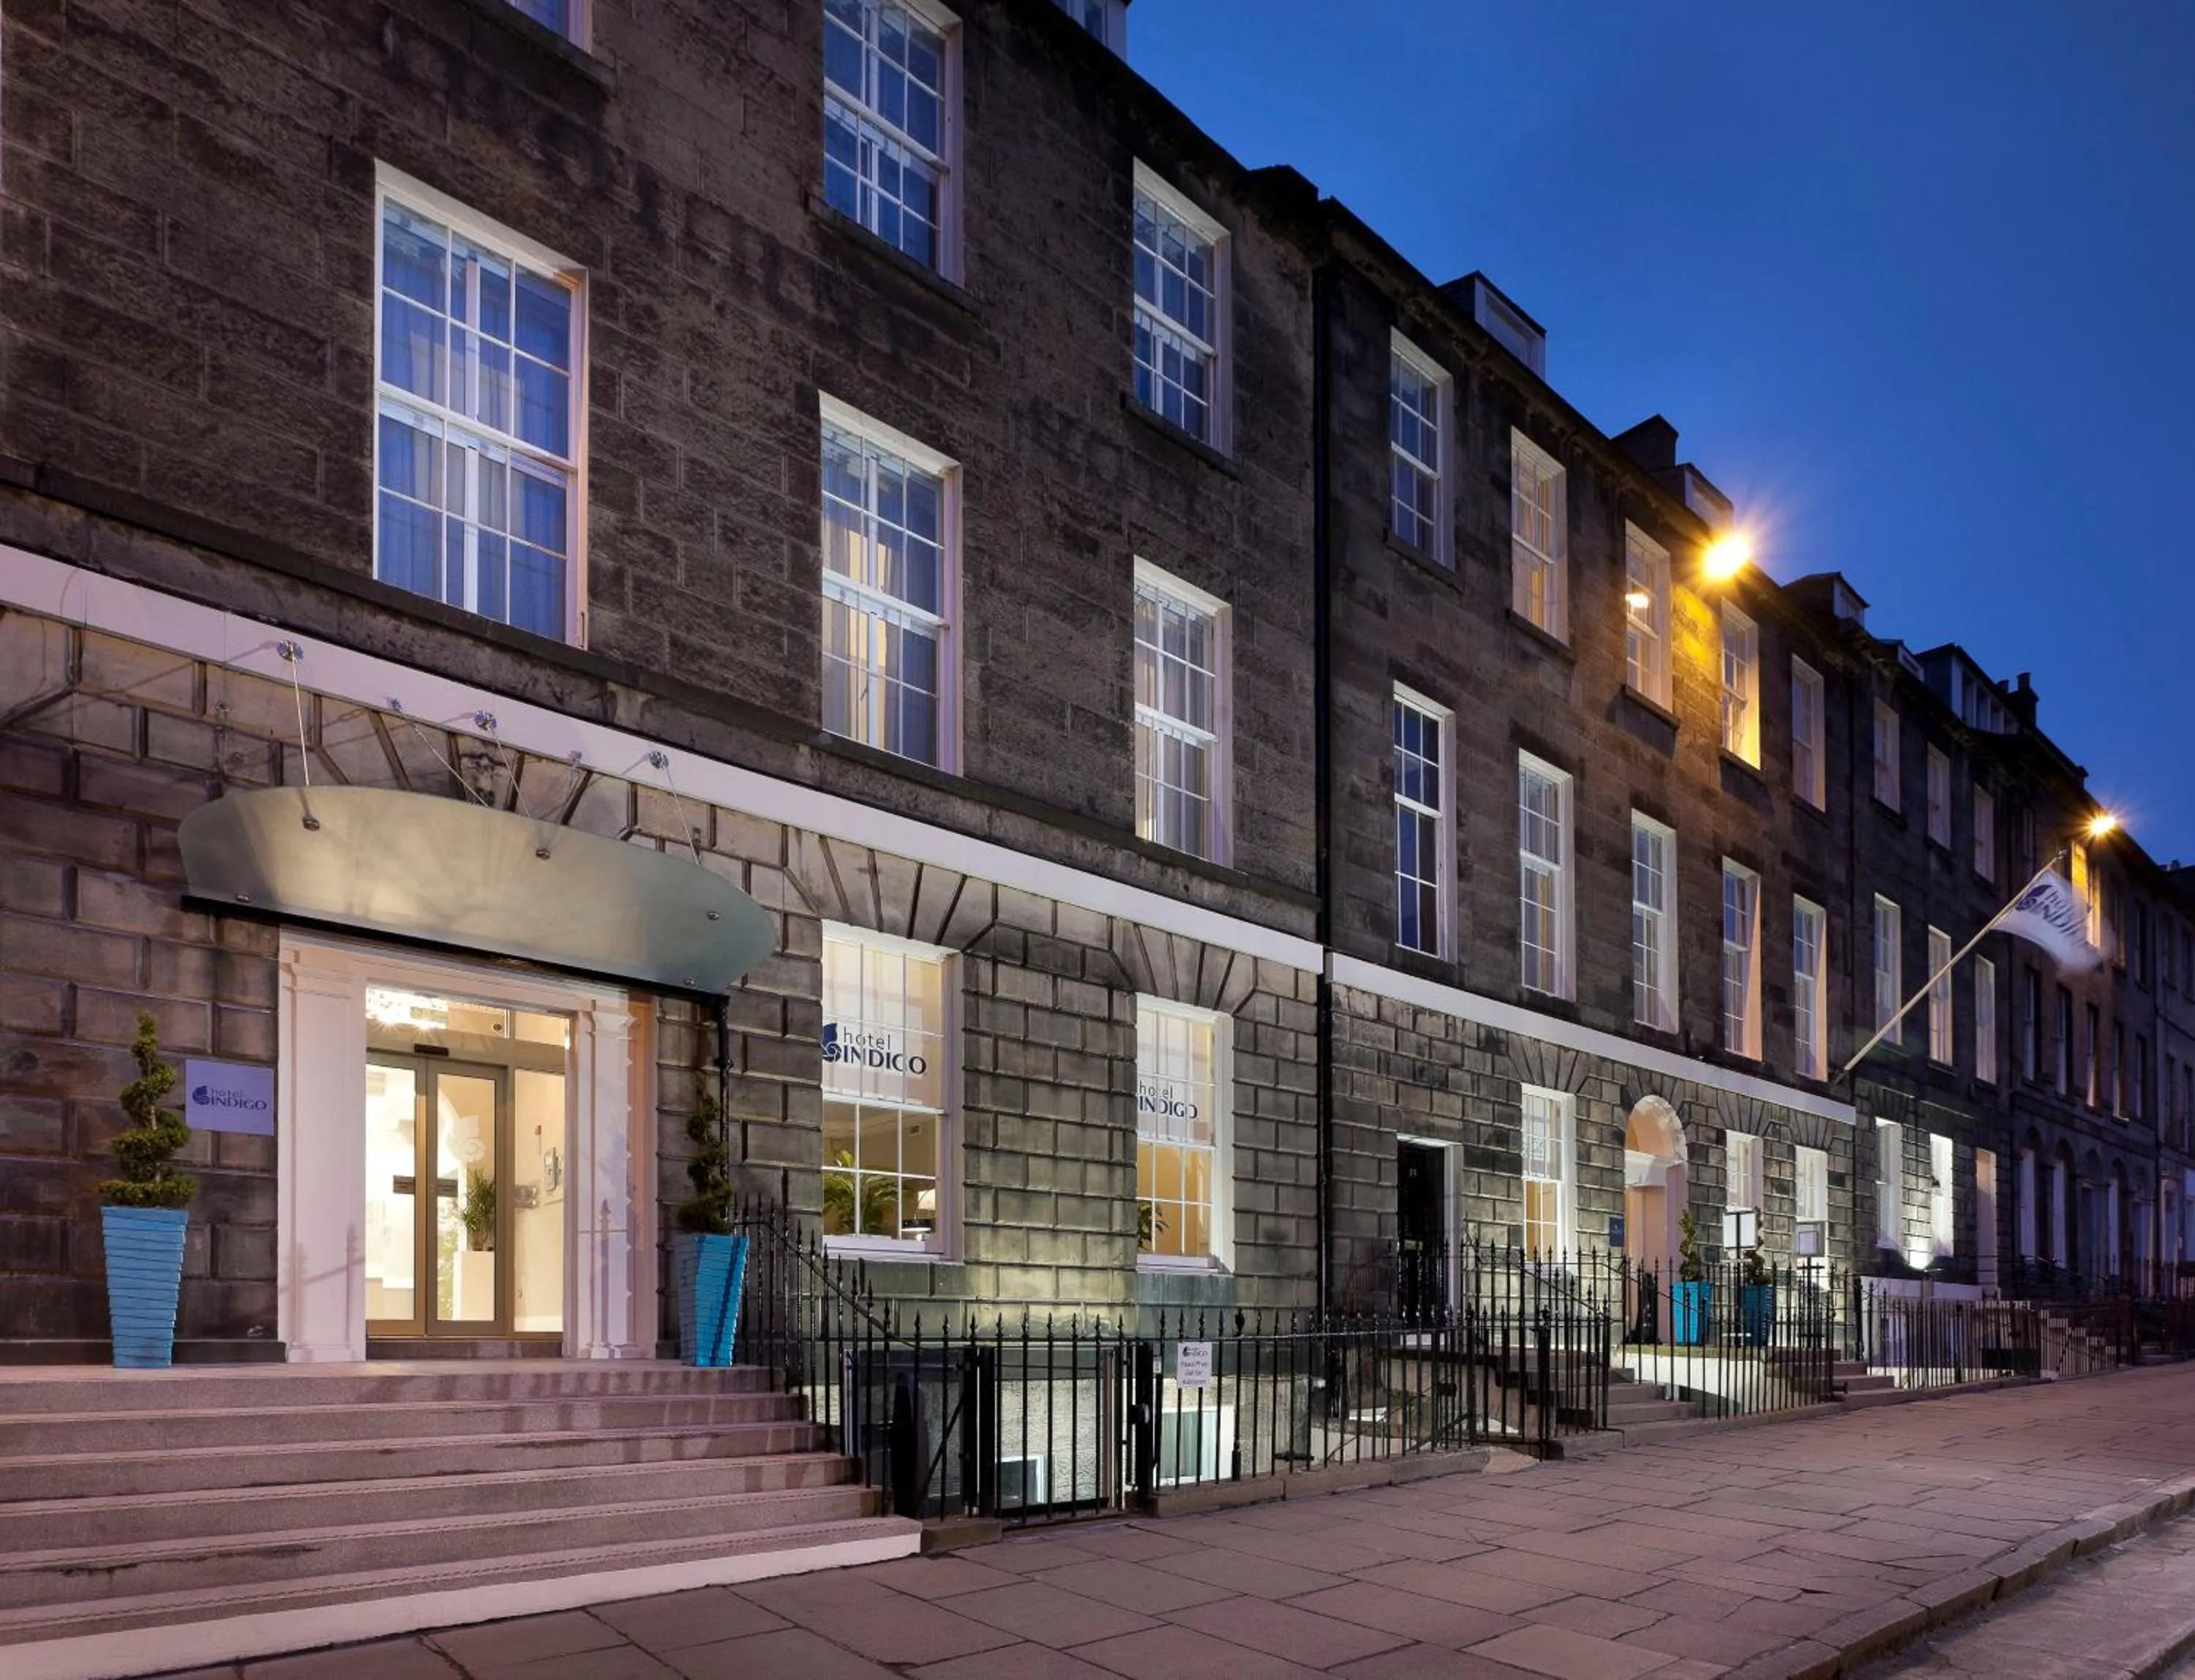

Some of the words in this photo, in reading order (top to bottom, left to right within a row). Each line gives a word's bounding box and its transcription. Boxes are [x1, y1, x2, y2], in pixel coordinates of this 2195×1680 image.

[844, 1027, 890, 1049] hotel
[843, 1045, 926, 1075] INDIGO
[1139, 1079, 1173, 1099] hoel
[211, 1097, 268, 1110] INDIGO
